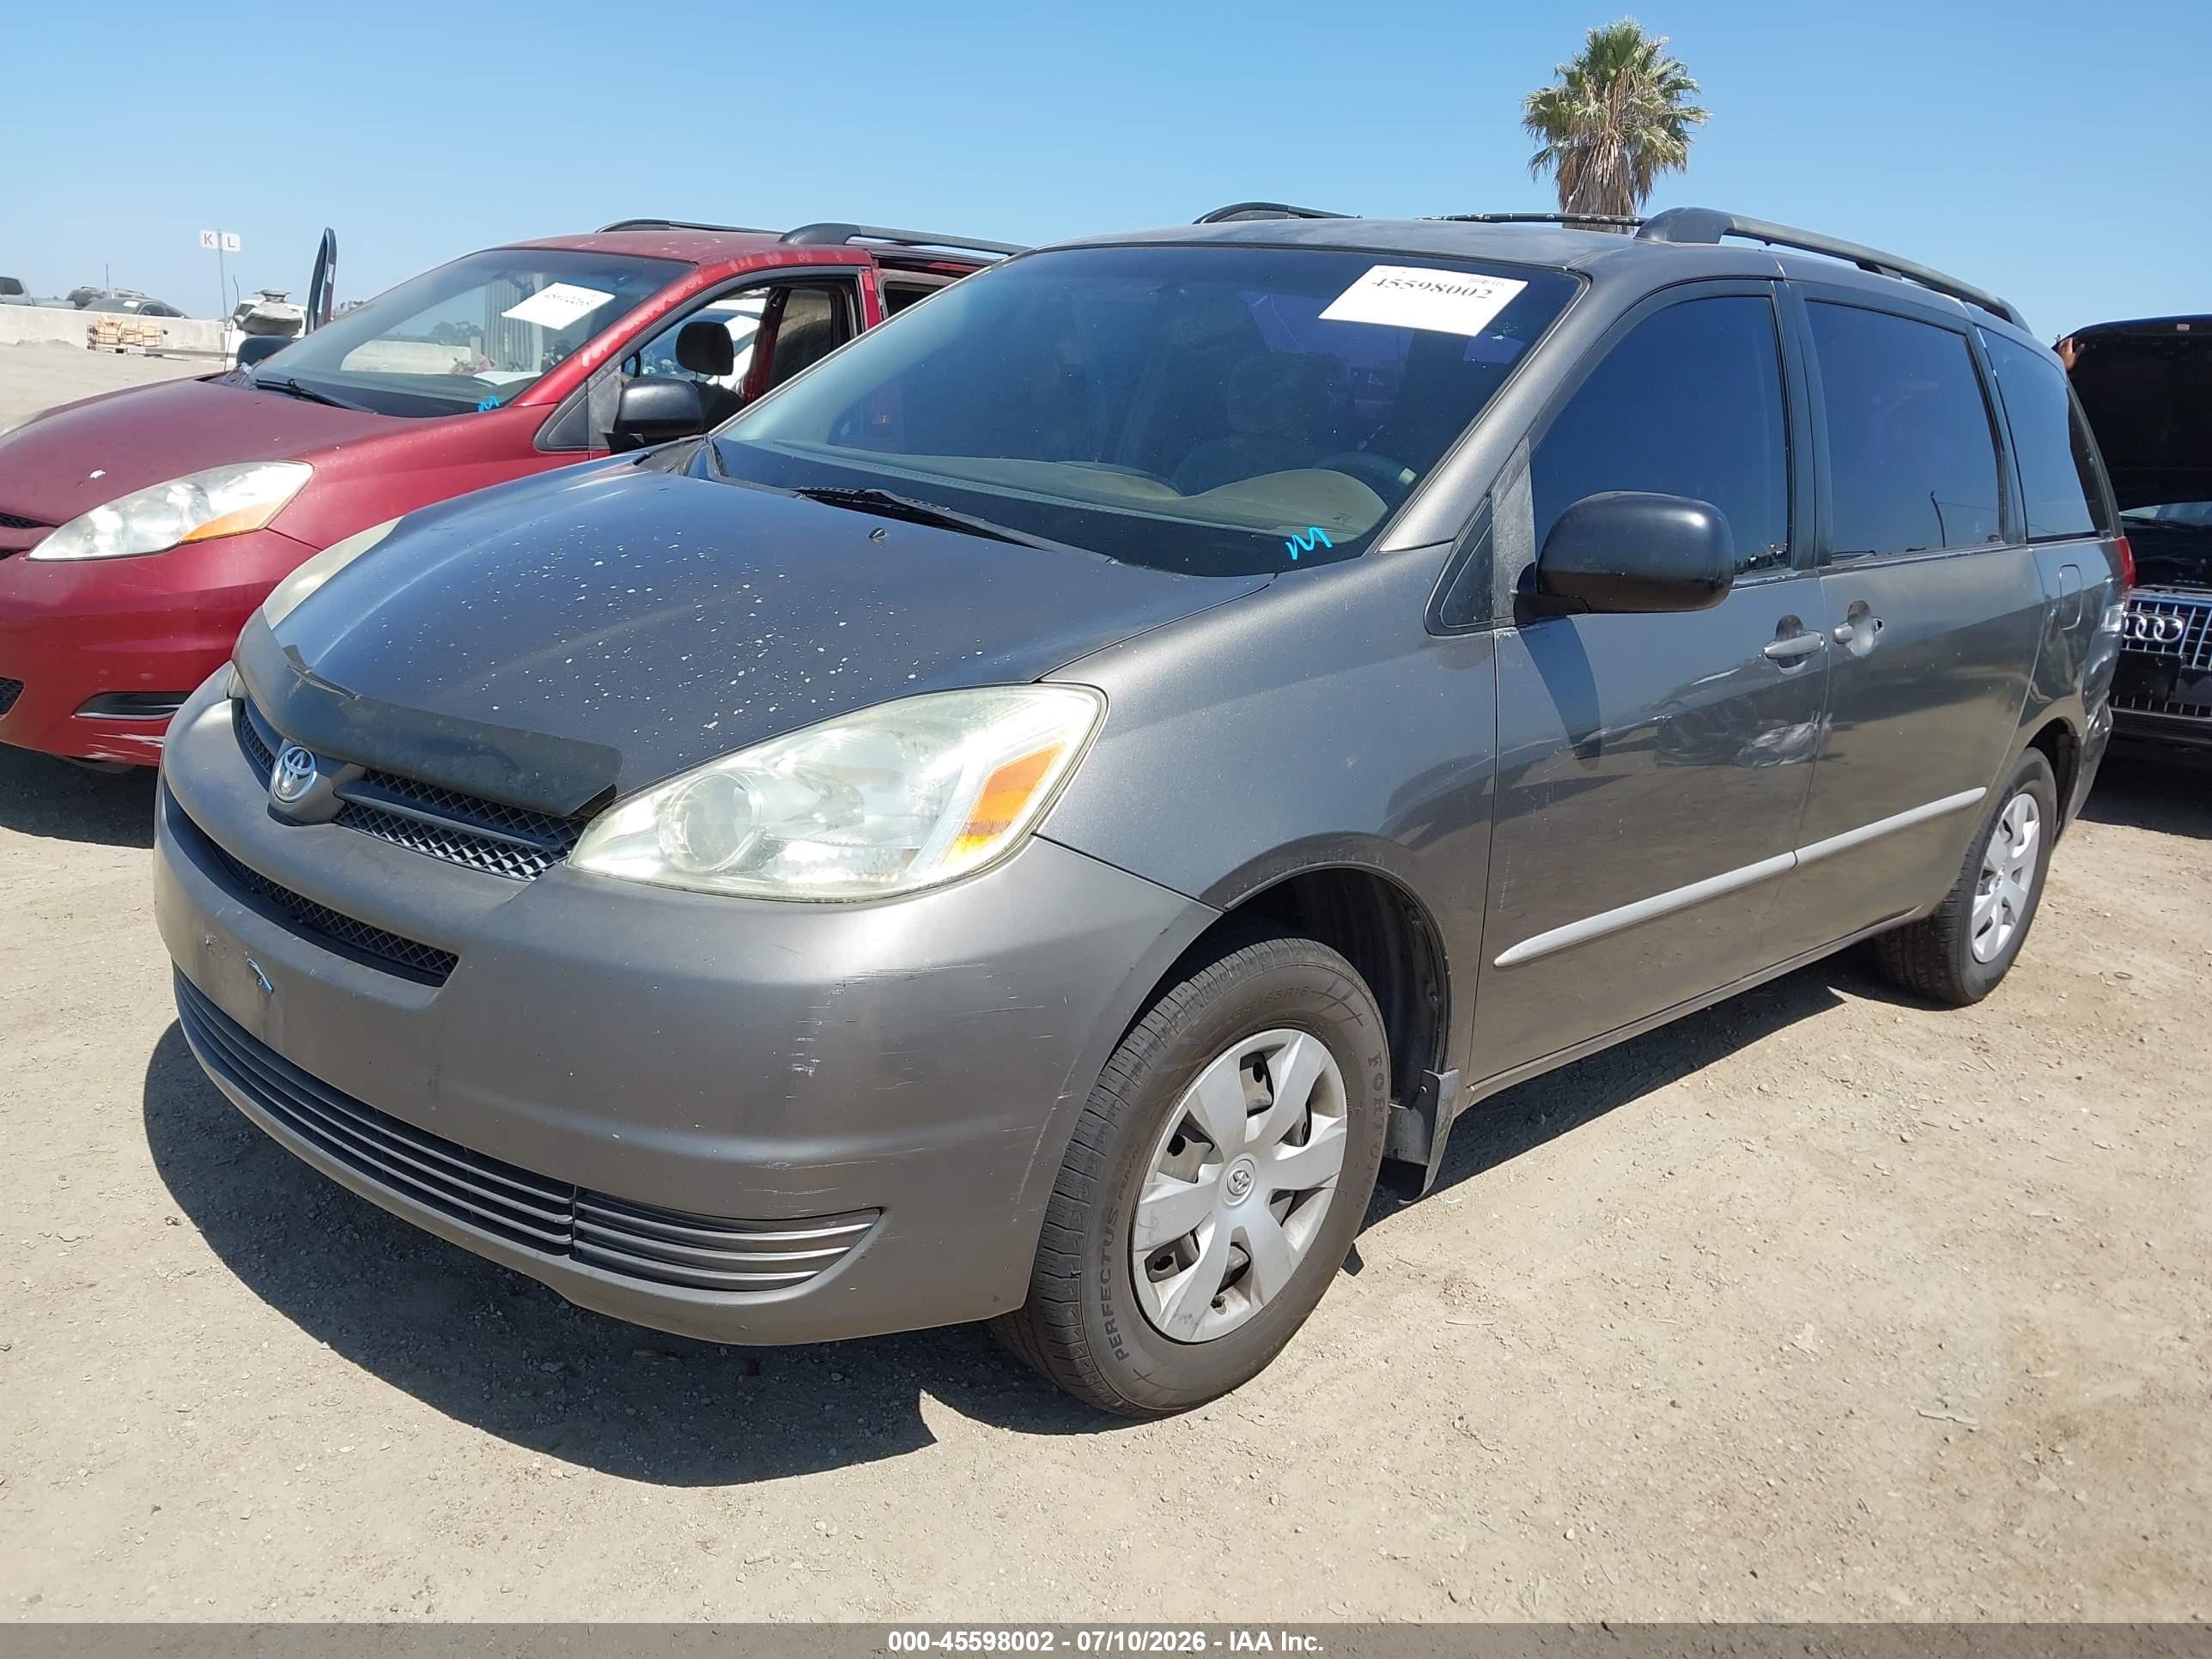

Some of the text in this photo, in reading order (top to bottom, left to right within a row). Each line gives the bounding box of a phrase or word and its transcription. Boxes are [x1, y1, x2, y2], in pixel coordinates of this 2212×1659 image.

[204, 233, 214, 246] K
[227, 235, 236, 248] L
[1370, 277, 1493, 300] 45598002
[1099, 1206, 1131, 1363] PERFECTUS
